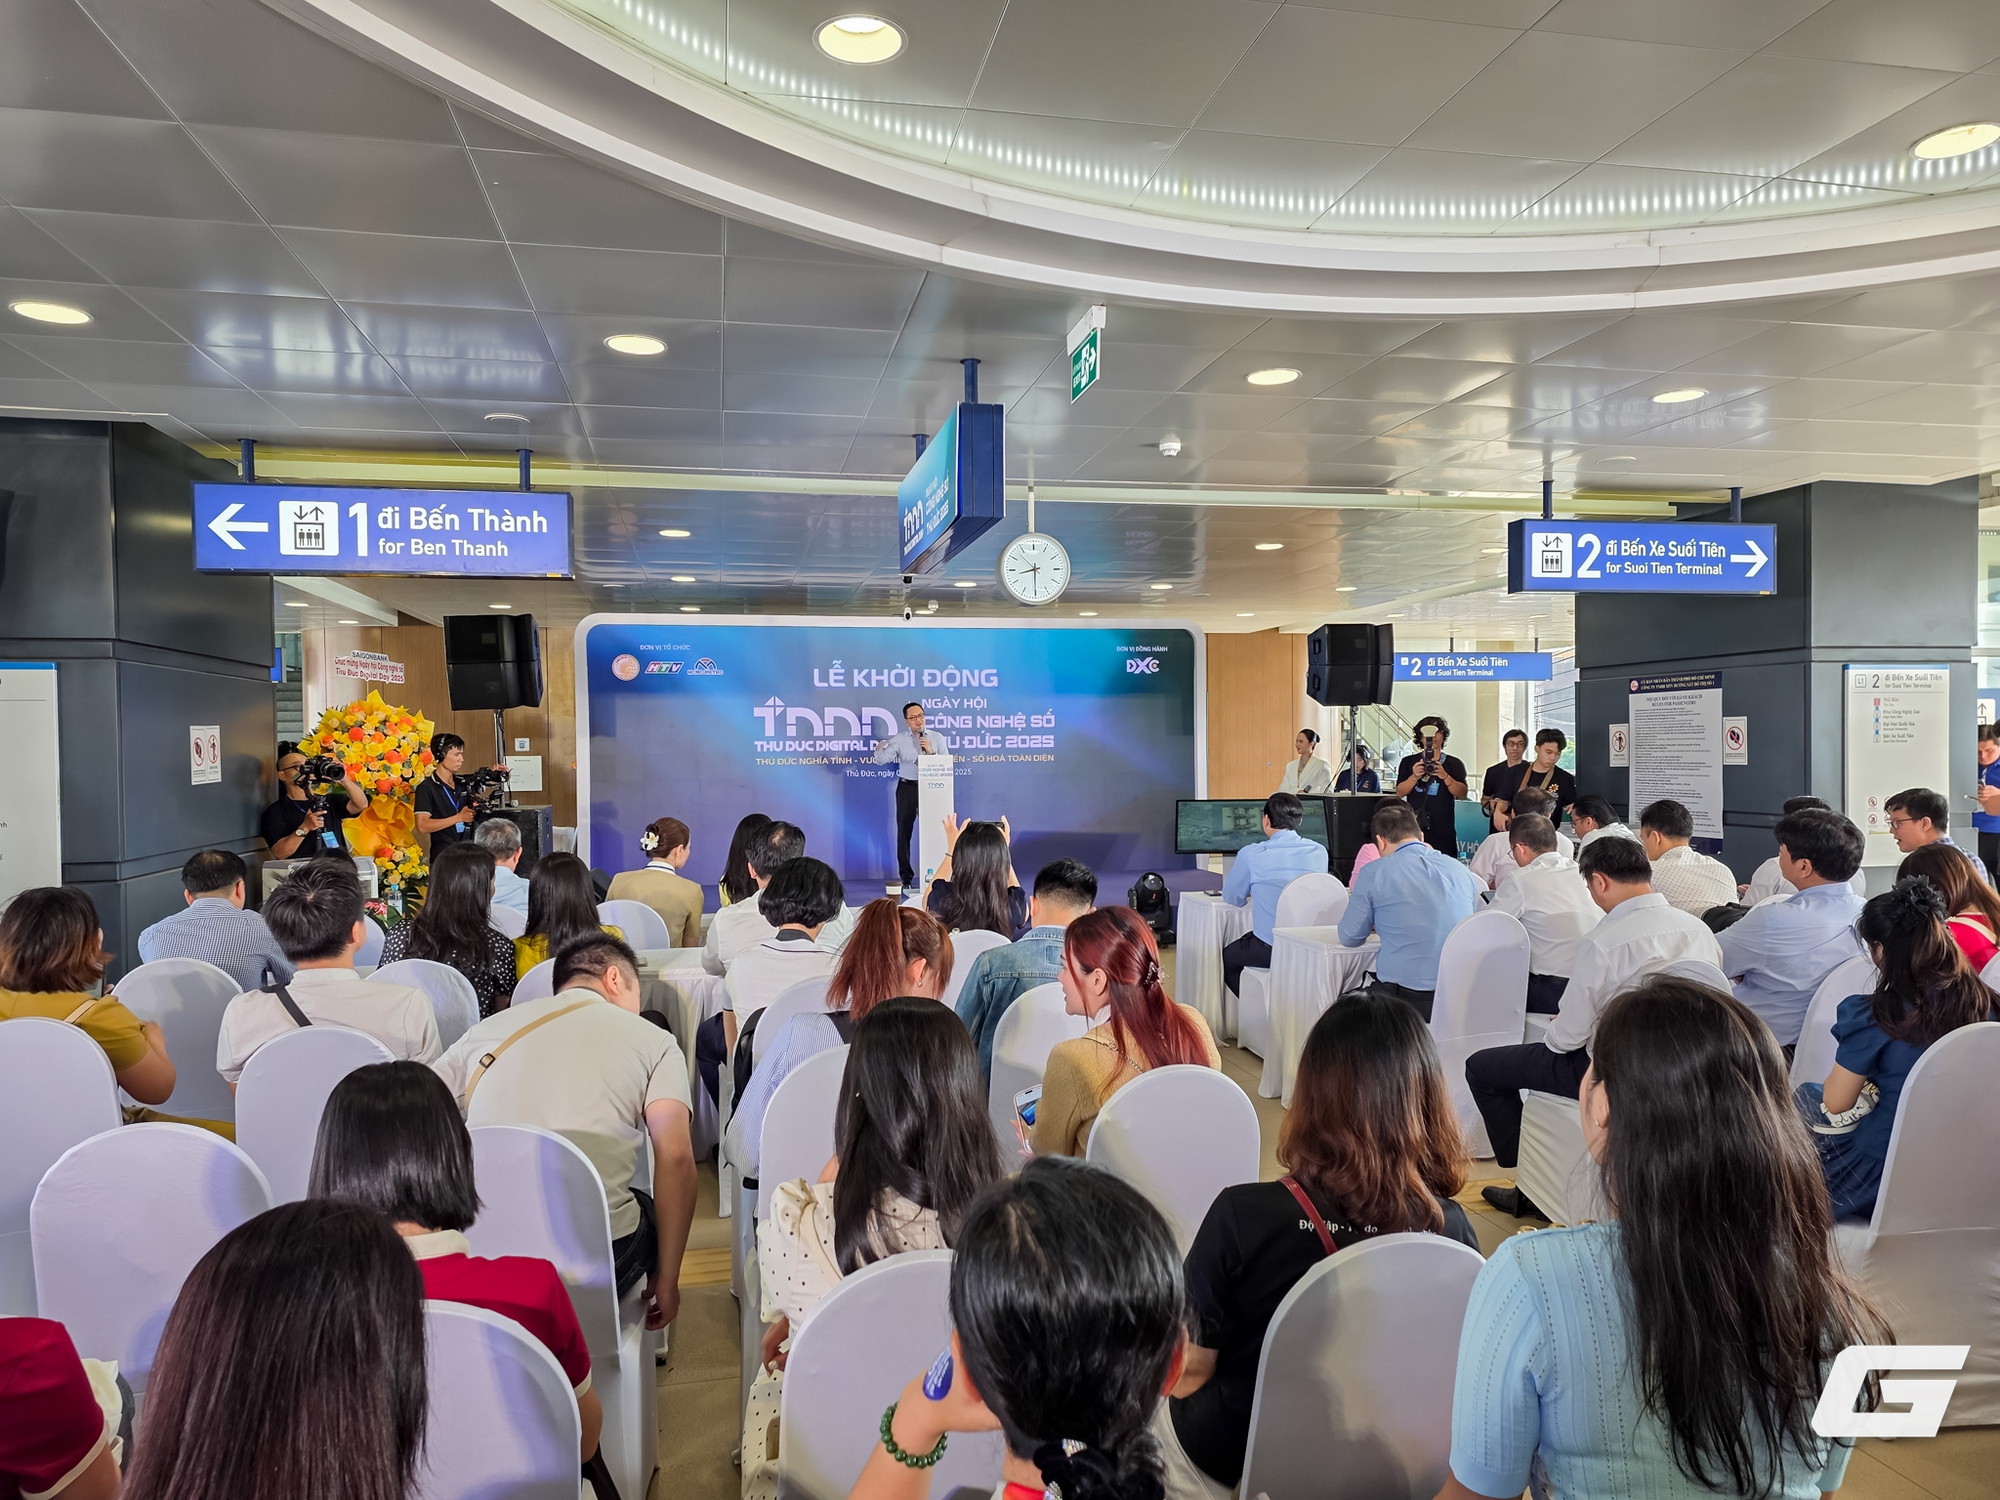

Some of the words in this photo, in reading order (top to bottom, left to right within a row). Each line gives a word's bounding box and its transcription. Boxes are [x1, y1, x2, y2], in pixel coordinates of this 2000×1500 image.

[377, 506, 400, 530] đi
[410, 503, 460, 533] Bến
[468, 508, 548, 534] Thành
[348, 502, 368, 556] 1
[378, 538, 405, 554] for
[410, 540, 446, 556] Ben
[452, 540, 508, 556] Thanh
[1606, 540, 1618, 556] đi
[1622, 538, 1646, 557] Bến
[1649, 540, 1666, 557] Xe
[1668, 538, 1696, 558] Suối
[1699, 541, 1726, 558] Tiên
[1576, 532, 1602, 578] 2
[1606, 562, 1620, 574] for
[1624, 562, 1648, 574] Suoi
[1651, 562, 1672, 574] Tien
[1676, 563, 1722, 575] Terminal
[352, 651, 388, 662] SAIGONBANK
[1427, 657, 1435, 666] đi
[1438, 656, 1454, 666] Bến
[1456, 657, 1467, 666] Xe
[1469, 656, 1488, 666] Suối
[1490, 657, 1508, 666] Tiên
[648, 662, 683, 672] HTV
[1126, 657, 1160, 674] DXC
[1411, 658, 1422, 676] 2
[391, 674, 404, 682] 2025
[813, 660, 846, 688] LỄ
[853, 664, 916, 688] KHỞI
[922, 666, 998, 692] ĐỘNG
[1872, 674, 1880, 688] 2
[922, 696, 960, 709] NGÀY
[964, 696, 987, 711] HỘI
[924, 712, 972, 729] CÔNG
[976, 712, 1026, 731] NGHỆ
[1030, 708, 1056, 728] SỐ
[754, 741, 783, 752] THU
[786, 741, 814, 752] DUC
[816, 740, 868, 751] DIGITAL
[962, 730, 1002, 749] ĐỨC
[1006, 735, 1054, 748] 2025
[756, 756, 775, 765] THỦ
[777, 756, 797, 765] ĐỨC
[799, 756, 829, 765] NGHĨA
[830, 756, 852, 764] TÌNH
[972, 753, 985, 762] SỐ
[986, 754, 1005, 762] HOÁ
[1007, 753, 1031, 762] TOÀN
[1034, 754, 1054, 763] DIỆN
[878, 770, 894, 778] ngày
